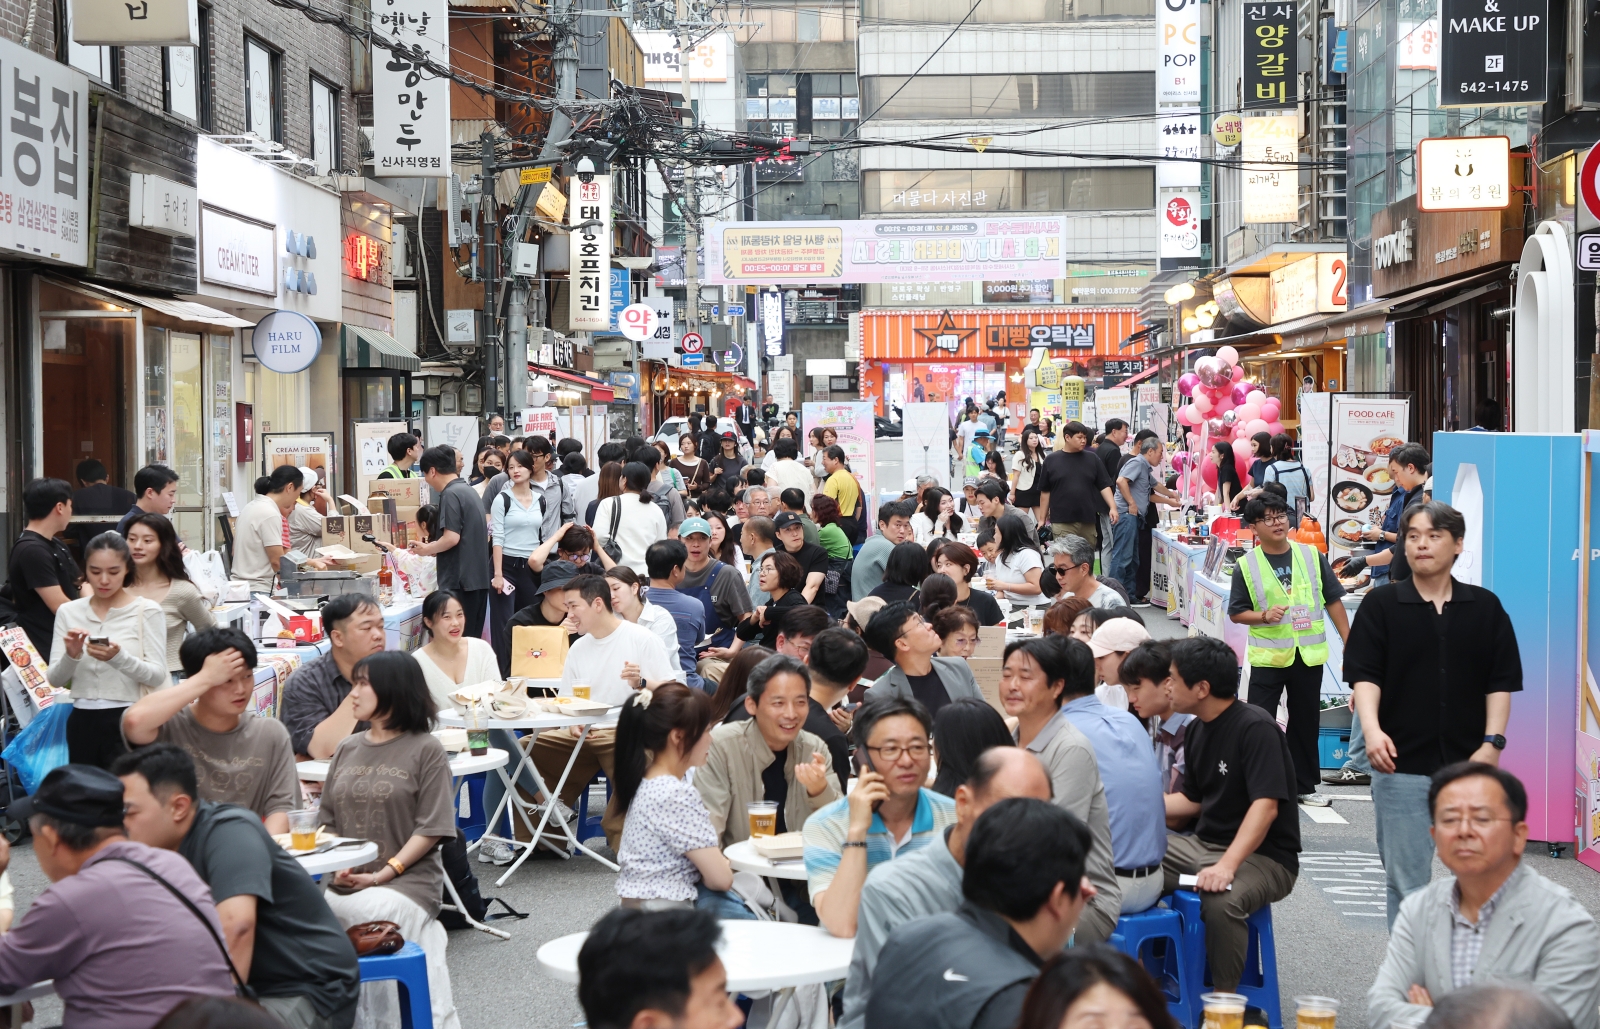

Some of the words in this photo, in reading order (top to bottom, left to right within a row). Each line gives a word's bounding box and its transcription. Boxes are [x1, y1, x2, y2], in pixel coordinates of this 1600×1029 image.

[1247, 4, 1293, 20] 신사
[381, 11, 431, 36] 옛날
[1449, 17, 1506, 33] MAKE
[1513, 16, 1540, 31] UP
[1165, 23, 1196, 45] PC
[643, 45, 715, 73] 개혁당
[1165, 54, 1196, 67] POP
[1255, 24, 1290, 104] 양갈비
[1487, 58, 1502, 68] 2F
[1460, 81, 1529, 94] 542-1475
[0, 60, 78, 200] 봉집
[1216, 121, 1242, 133] 노래방
[381, 156, 441, 168] 신사직영점
[892, 190, 938, 206] 머물다
[941, 190, 988, 206] 사진관
[18, 197, 58, 235] 삼겹살전문
[218, 247, 240, 272] CREAM
[241, 252, 260, 277] FILTER
[579, 206, 600, 311] 태호프치킨
[625, 310, 652, 336] 약
[268, 332, 302, 342] HARU
[987, 325, 1094, 348] 대빵오락실
[271, 344, 301, 354] FILM
[1122, 361, 1143, 372] 치과
[529, 414, 539, 422] WE
[540, 412, 552, 420] ARE
[525, 422, 556, 432] DIFFEREN
